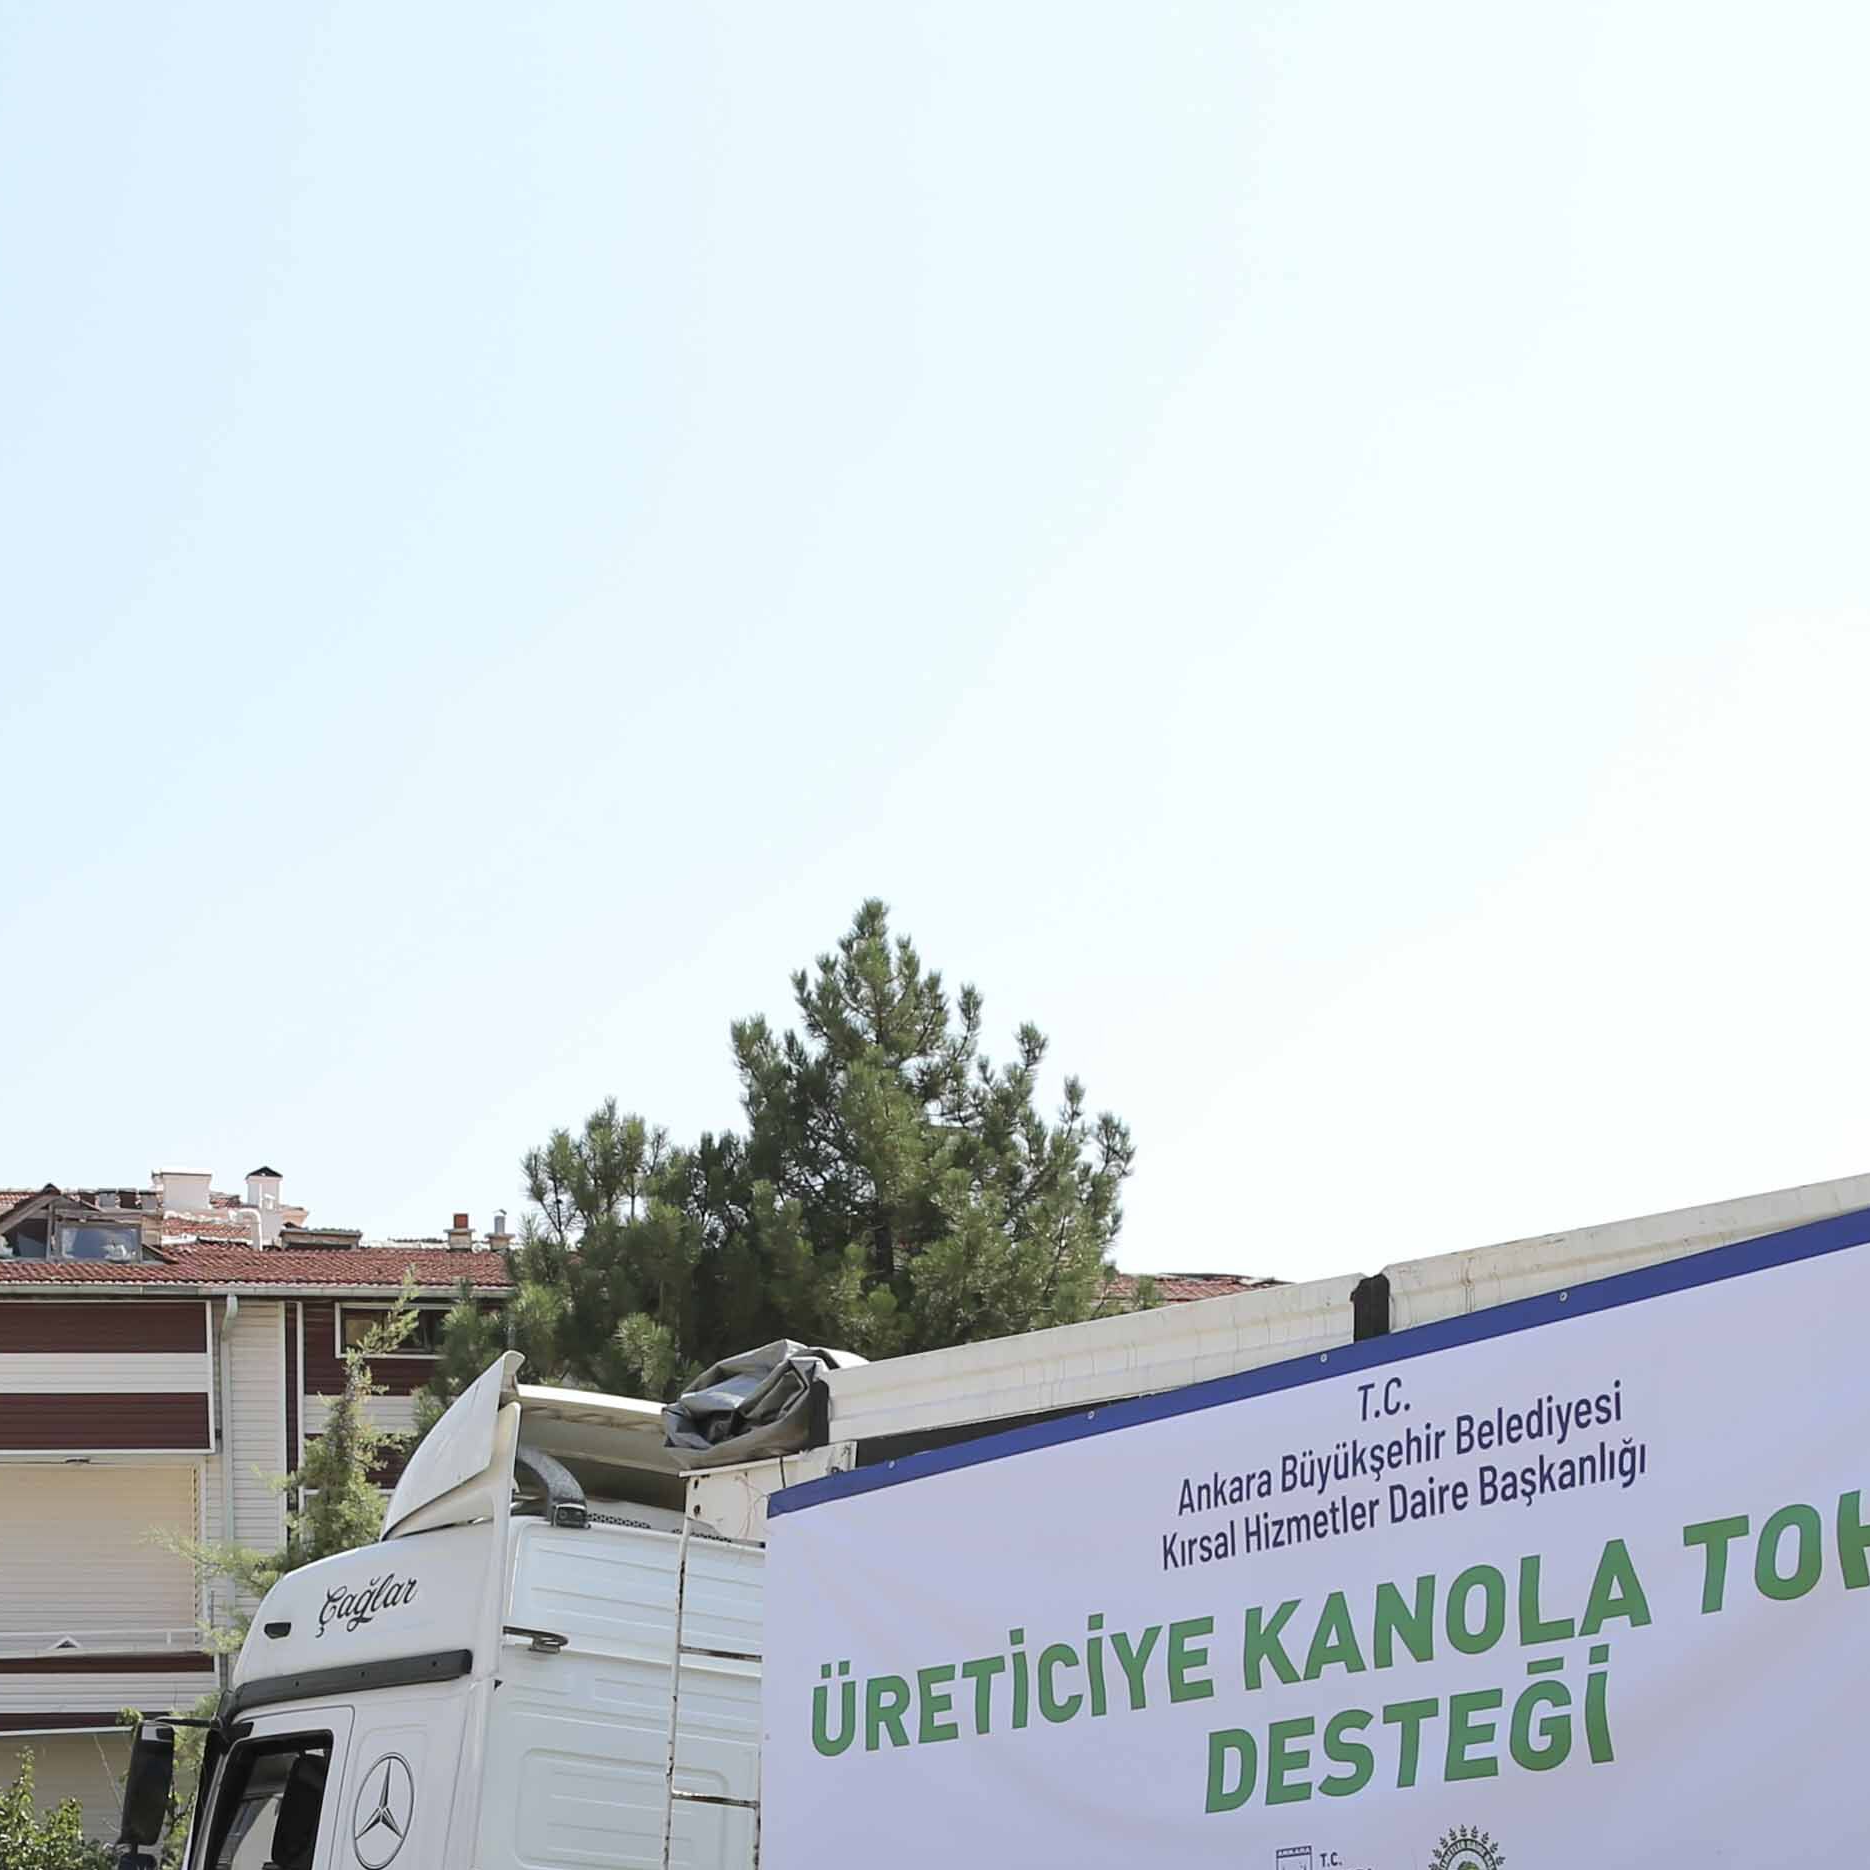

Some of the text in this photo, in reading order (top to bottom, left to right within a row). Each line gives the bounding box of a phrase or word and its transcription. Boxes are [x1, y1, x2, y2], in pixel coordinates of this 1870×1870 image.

[1178, 1379, 1623, 1516] Ankara Büyükşehir Belediyesi
[1357, 1376, 1411, 1422] T.C.
[1162, 1438, 1648, 1571] Kırsal Hizmetler Daire Başkanlığı
[315, 1573, 419, 1638] Çağlar
[811, 1613, 1215, 1757] ÜRETİCİYE
[1242, 1538, 1653, 1692] KANOLA
[1205, 1643, 1614, 1813] DESTEĞİ
[1319, 1852, 1343, 1867] T.C.
